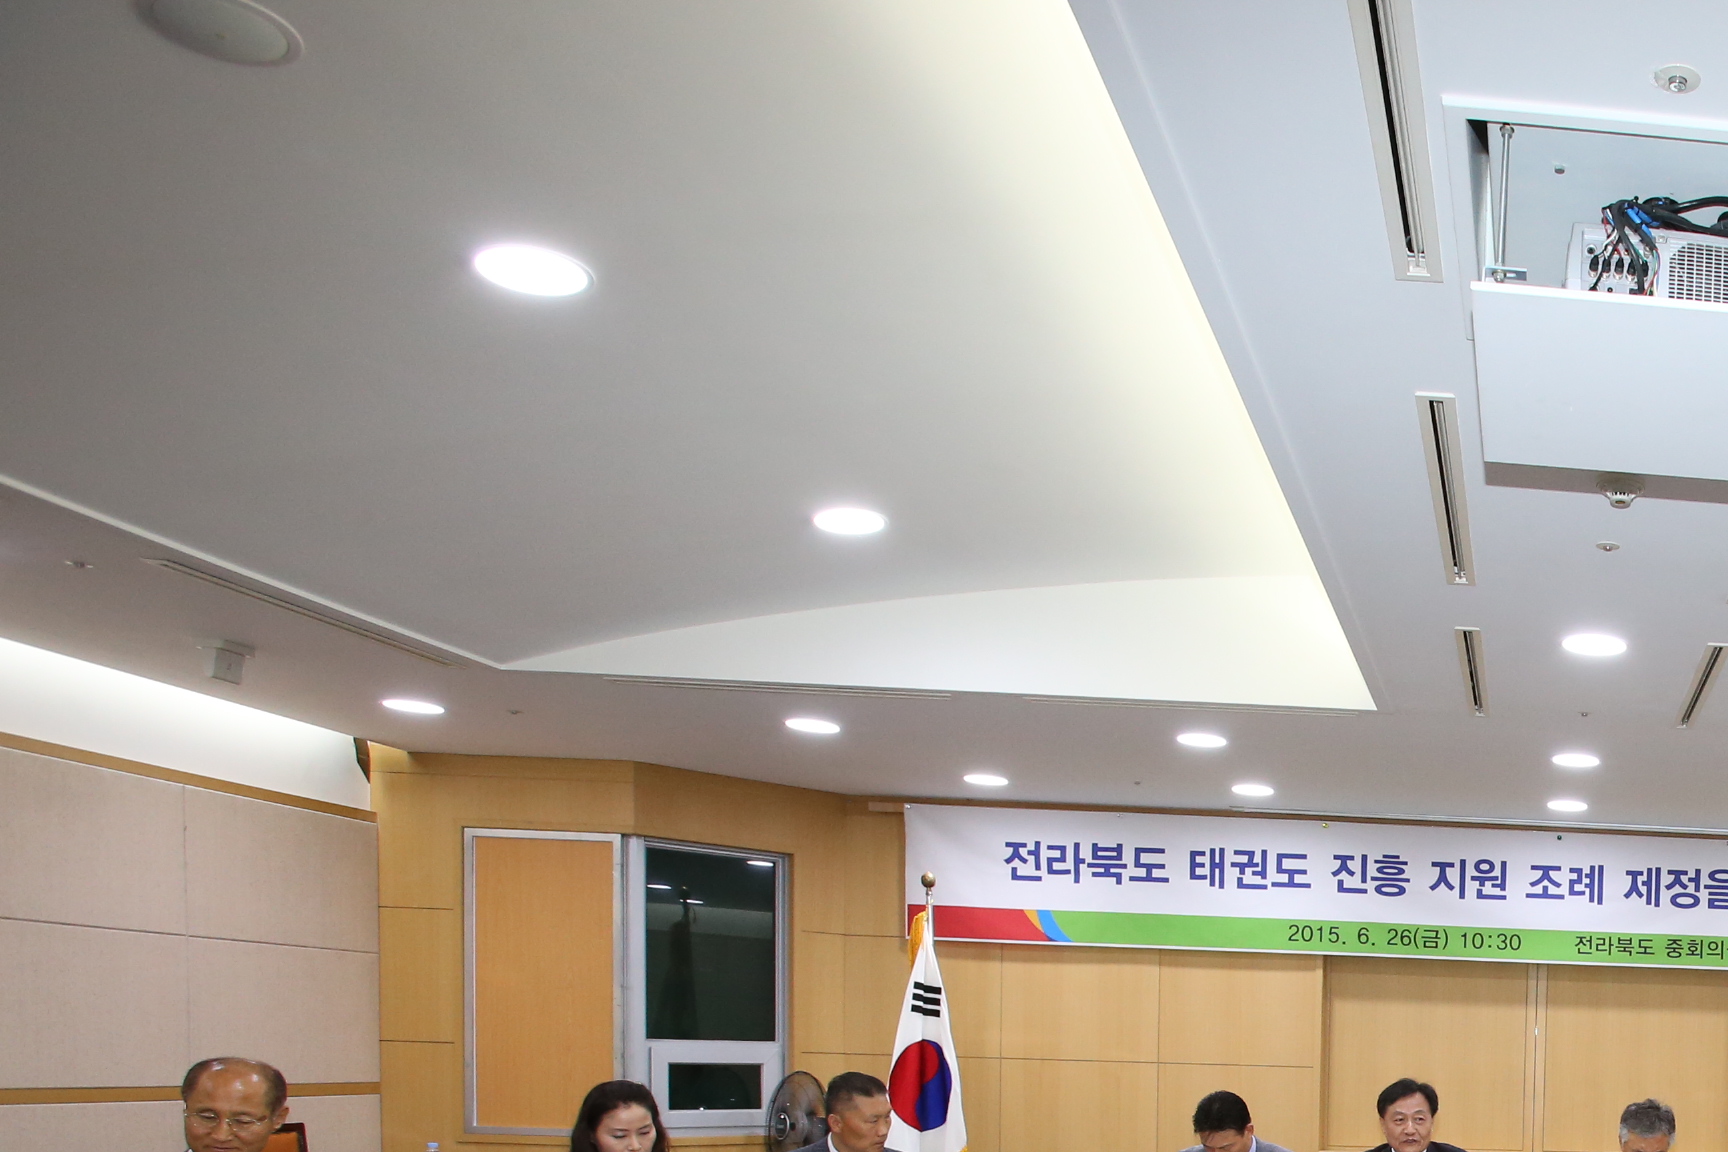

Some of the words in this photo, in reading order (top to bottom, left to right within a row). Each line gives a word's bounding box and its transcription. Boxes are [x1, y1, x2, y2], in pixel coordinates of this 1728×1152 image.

[1002, 840, 1170, 885] 전라북도
[1189, 848, 1312, 892] 태권도
[1331, 853, 1411, 898] 진흥
[1429, 857, 1509, 901] 지원
[1525, 862, 1605, 906] 조례
[1287, 924, 1348, 946] 2015.
[1357, 927, 1377, 947] 6.
[1386, 927, 1450, 952] 26(금)
[1460, 931, 1523, 953] 10:30
[1574, 934, 1656, 958] 전라북도
